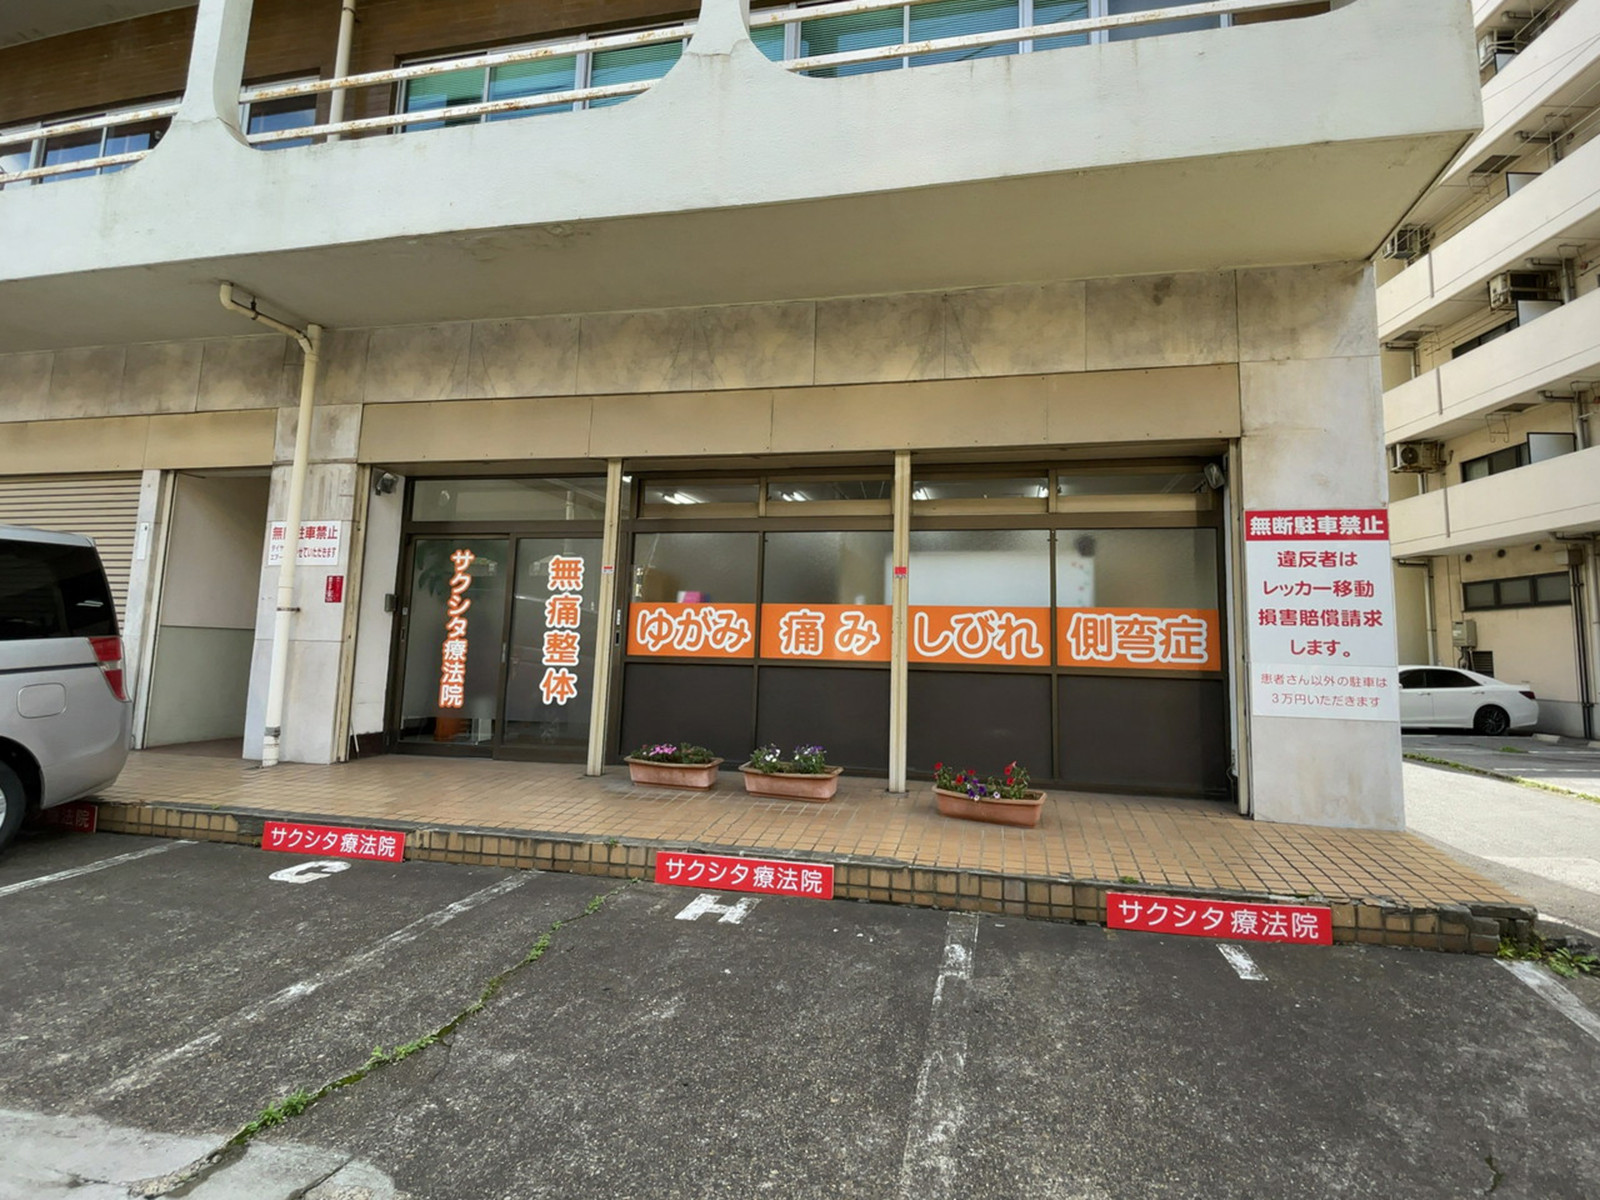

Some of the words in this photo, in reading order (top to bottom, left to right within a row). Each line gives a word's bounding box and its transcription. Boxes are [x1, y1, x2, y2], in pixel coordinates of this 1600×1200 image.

[272, 526, 338, 540] 無車禁止
[1249, 515, 1384, 536] 無断駐車禁止
[1277, 550, 1359, 569] 違反者は
[1263, 579, 1374, 598] レッカー移動
[438, 549, 475, 708] サクシタ療法院
[539, 554, 584, 705] 無痛整体
[636, 606, 752, 652] ゆがみ
[779, 608, 880, 656] 痛み
[1258, 608, 1383, 628] 損害賠償請求
[913, 609, 1044, 660] しびれ
[1066, 613, 1209, 664] 側弯症
[1290, 639, 1351, 658] します。
[1261, 673, 1388, 688] 患者さん以外の駐車は
[1271, 693, 1381, 708] 3万円いただきます
[271, 827, 396, 857] サクシタ療法院
[665, 857, 823, 894] サクシタ療法院
[674, 893, 762, 925] H
[1118, 900, 1320, 939] サクシタ療法院
